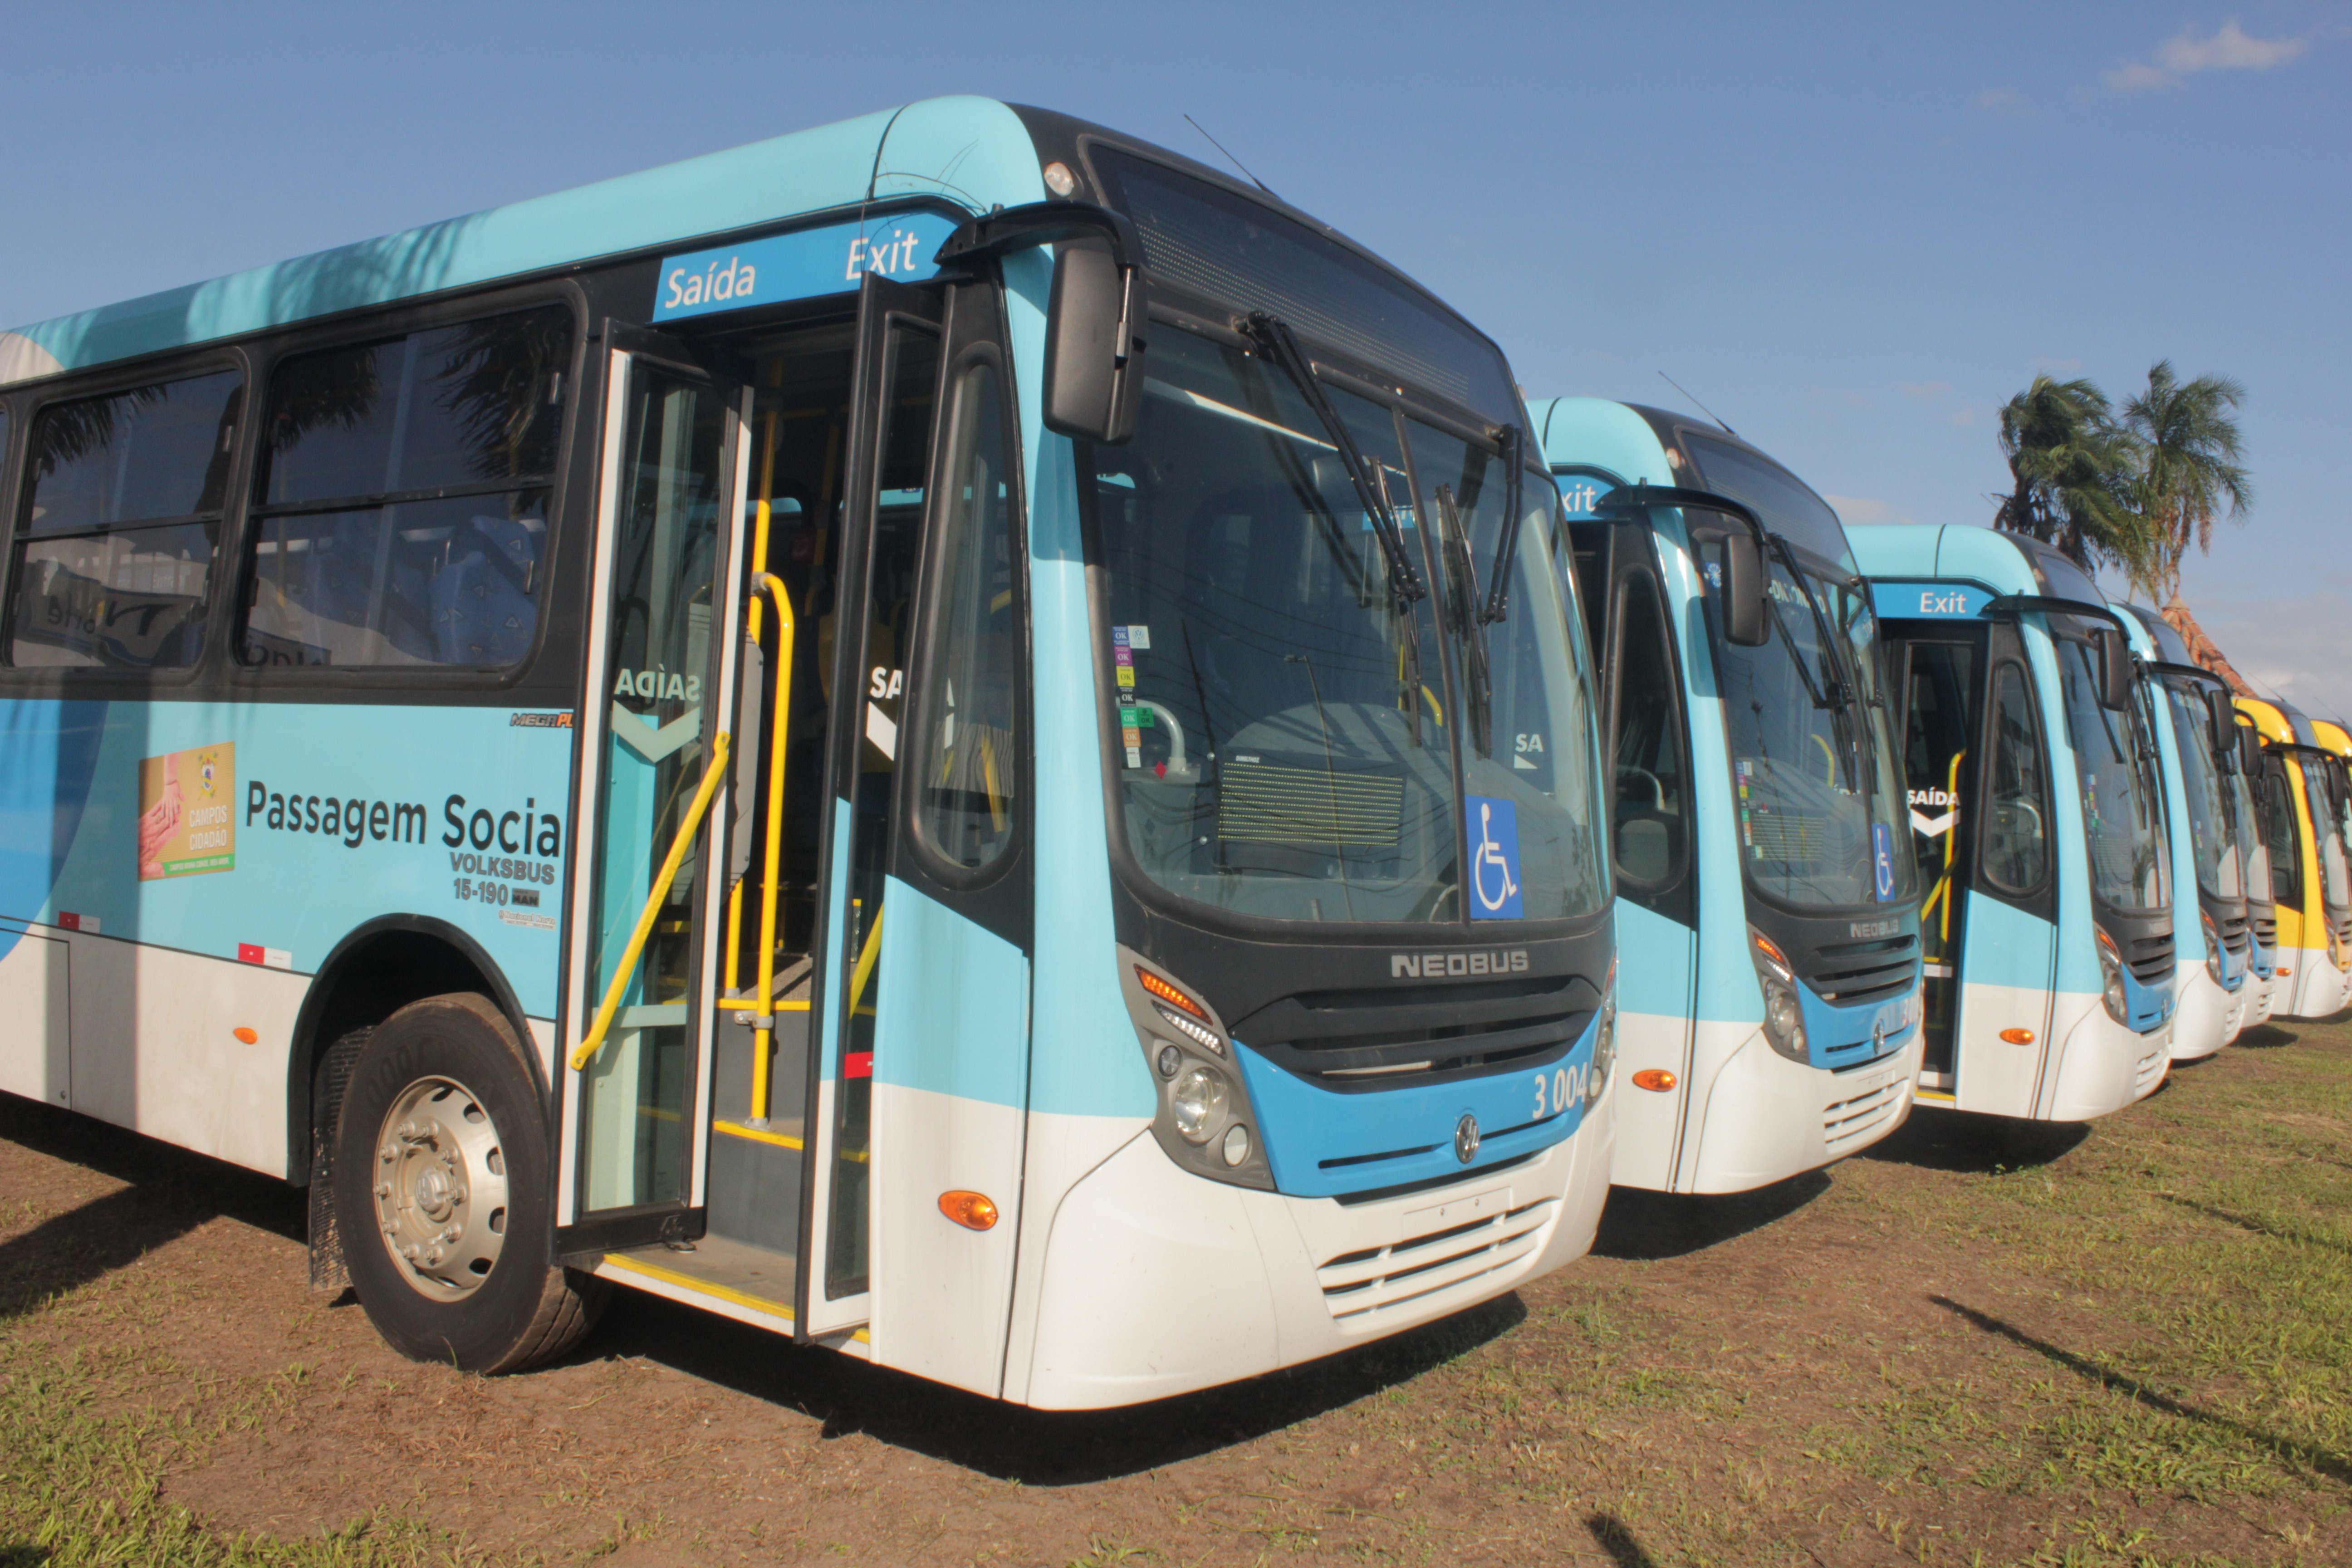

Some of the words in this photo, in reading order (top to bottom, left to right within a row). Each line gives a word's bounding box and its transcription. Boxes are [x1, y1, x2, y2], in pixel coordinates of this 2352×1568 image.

[664, 256, 755, 309] Saída
[846, 229, 919, 280] Exit
[1920, 591, 1968, 613] Exit
[1906, 786, 1961, 806] SAÍDA
[189, 804, 228, 828] CAMPOS
[246, 780, 427, 848] Passagem
[189, 827, 228, 851] CIDADÃO
[449, 852, 555, 885] VOLKSBUS
[454, 877, 509, 906] 15-190
[512, 894, 539, 906] MAN
[1850, 918, 1900, 938] NEOBUS
[1391, 950, 1529, 978] NEOBUS
[1553, 1061, 1588, 1113] 004
